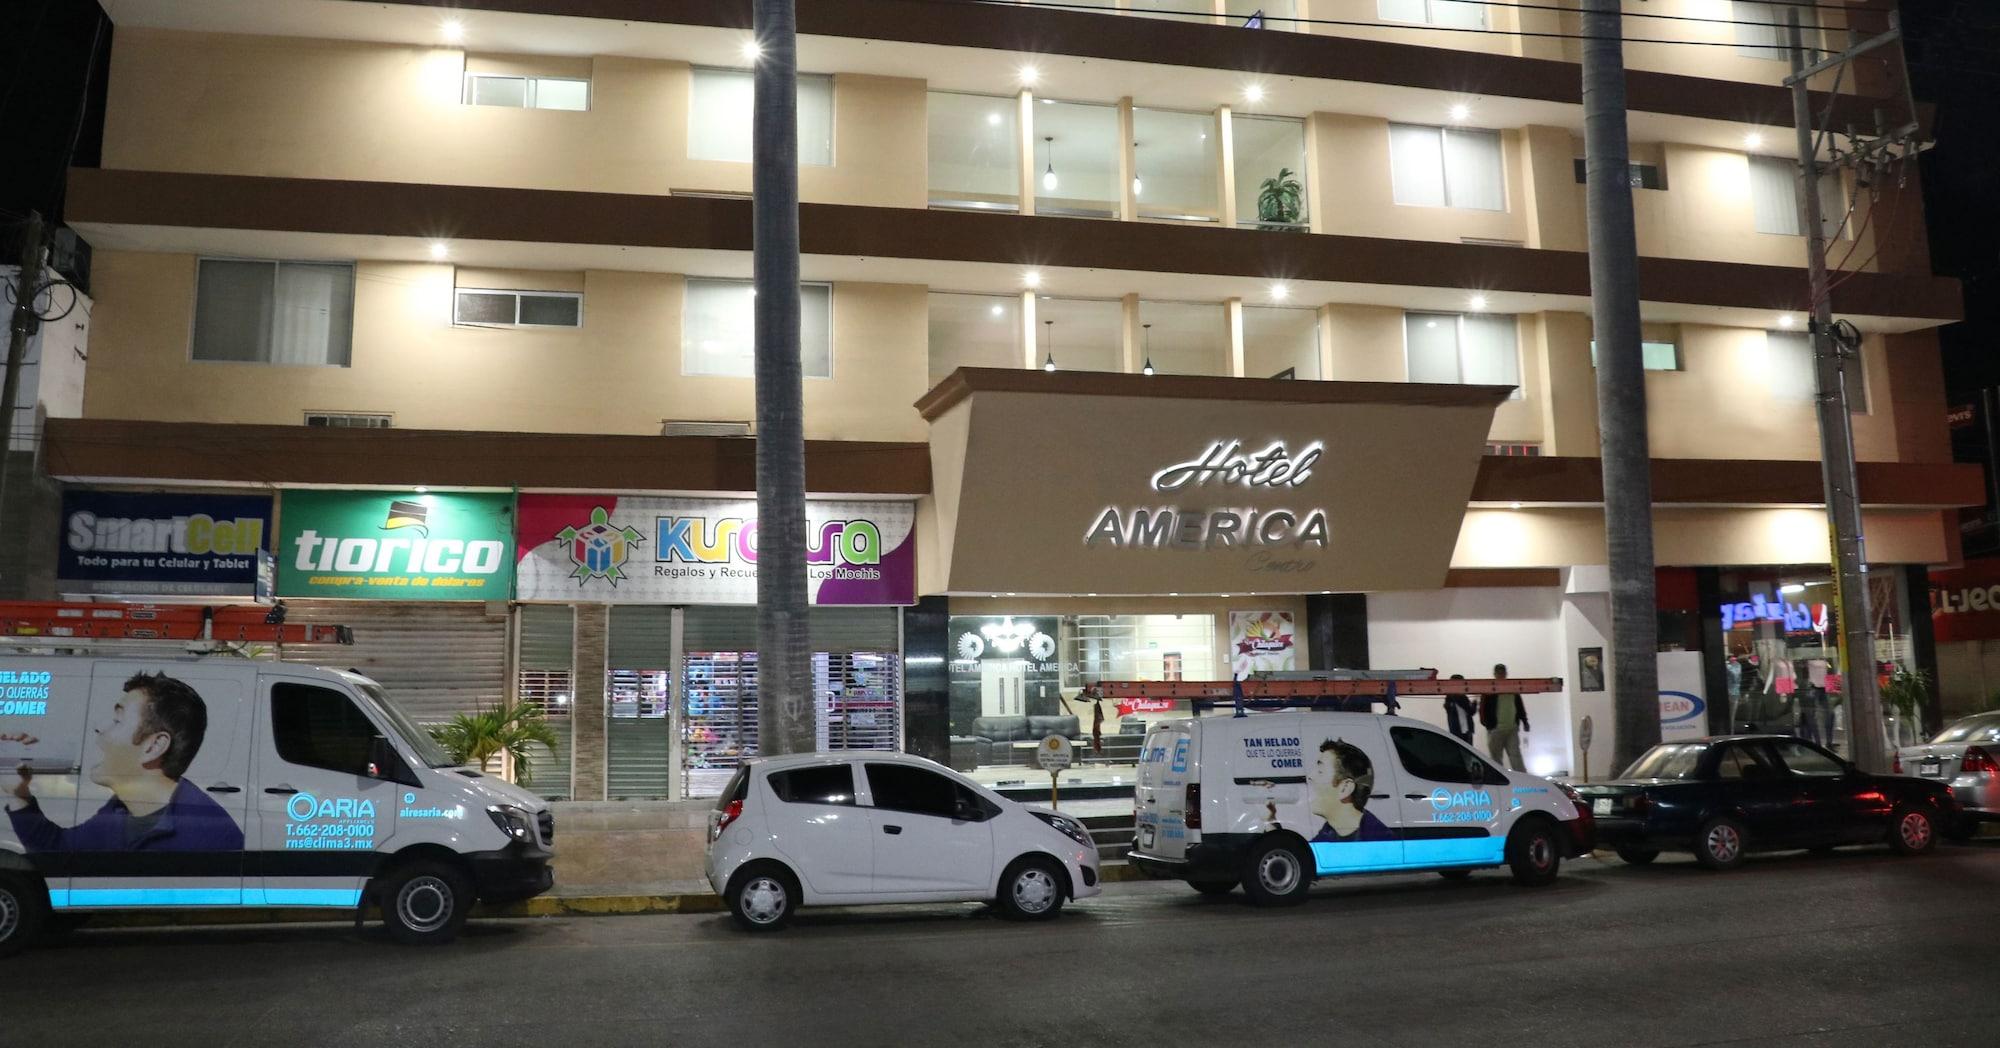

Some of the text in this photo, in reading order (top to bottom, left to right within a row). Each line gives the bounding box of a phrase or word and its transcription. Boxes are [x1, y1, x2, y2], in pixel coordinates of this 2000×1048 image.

[1152, 441, 1322, 491] Hotel
[68, 511, 264, 555] SmartCell
[1085, 506, 1329, 549] AMERICA
[295, 530, 504, 574] tiorico
[77, 556, 250, 571] Todo para tu Celular y Tablet
[654, 566, 881, 580] Regalos y Recue Los Mochis
[411, 576, 430, 586] de
[6, 686, 49, 699] QUERRÁS
[1244, 737, 1300, 748] TAN HELADO
[1271, 759, 1303, 768] COMER
[286, 824, 375, 837] T.662-208-0100
